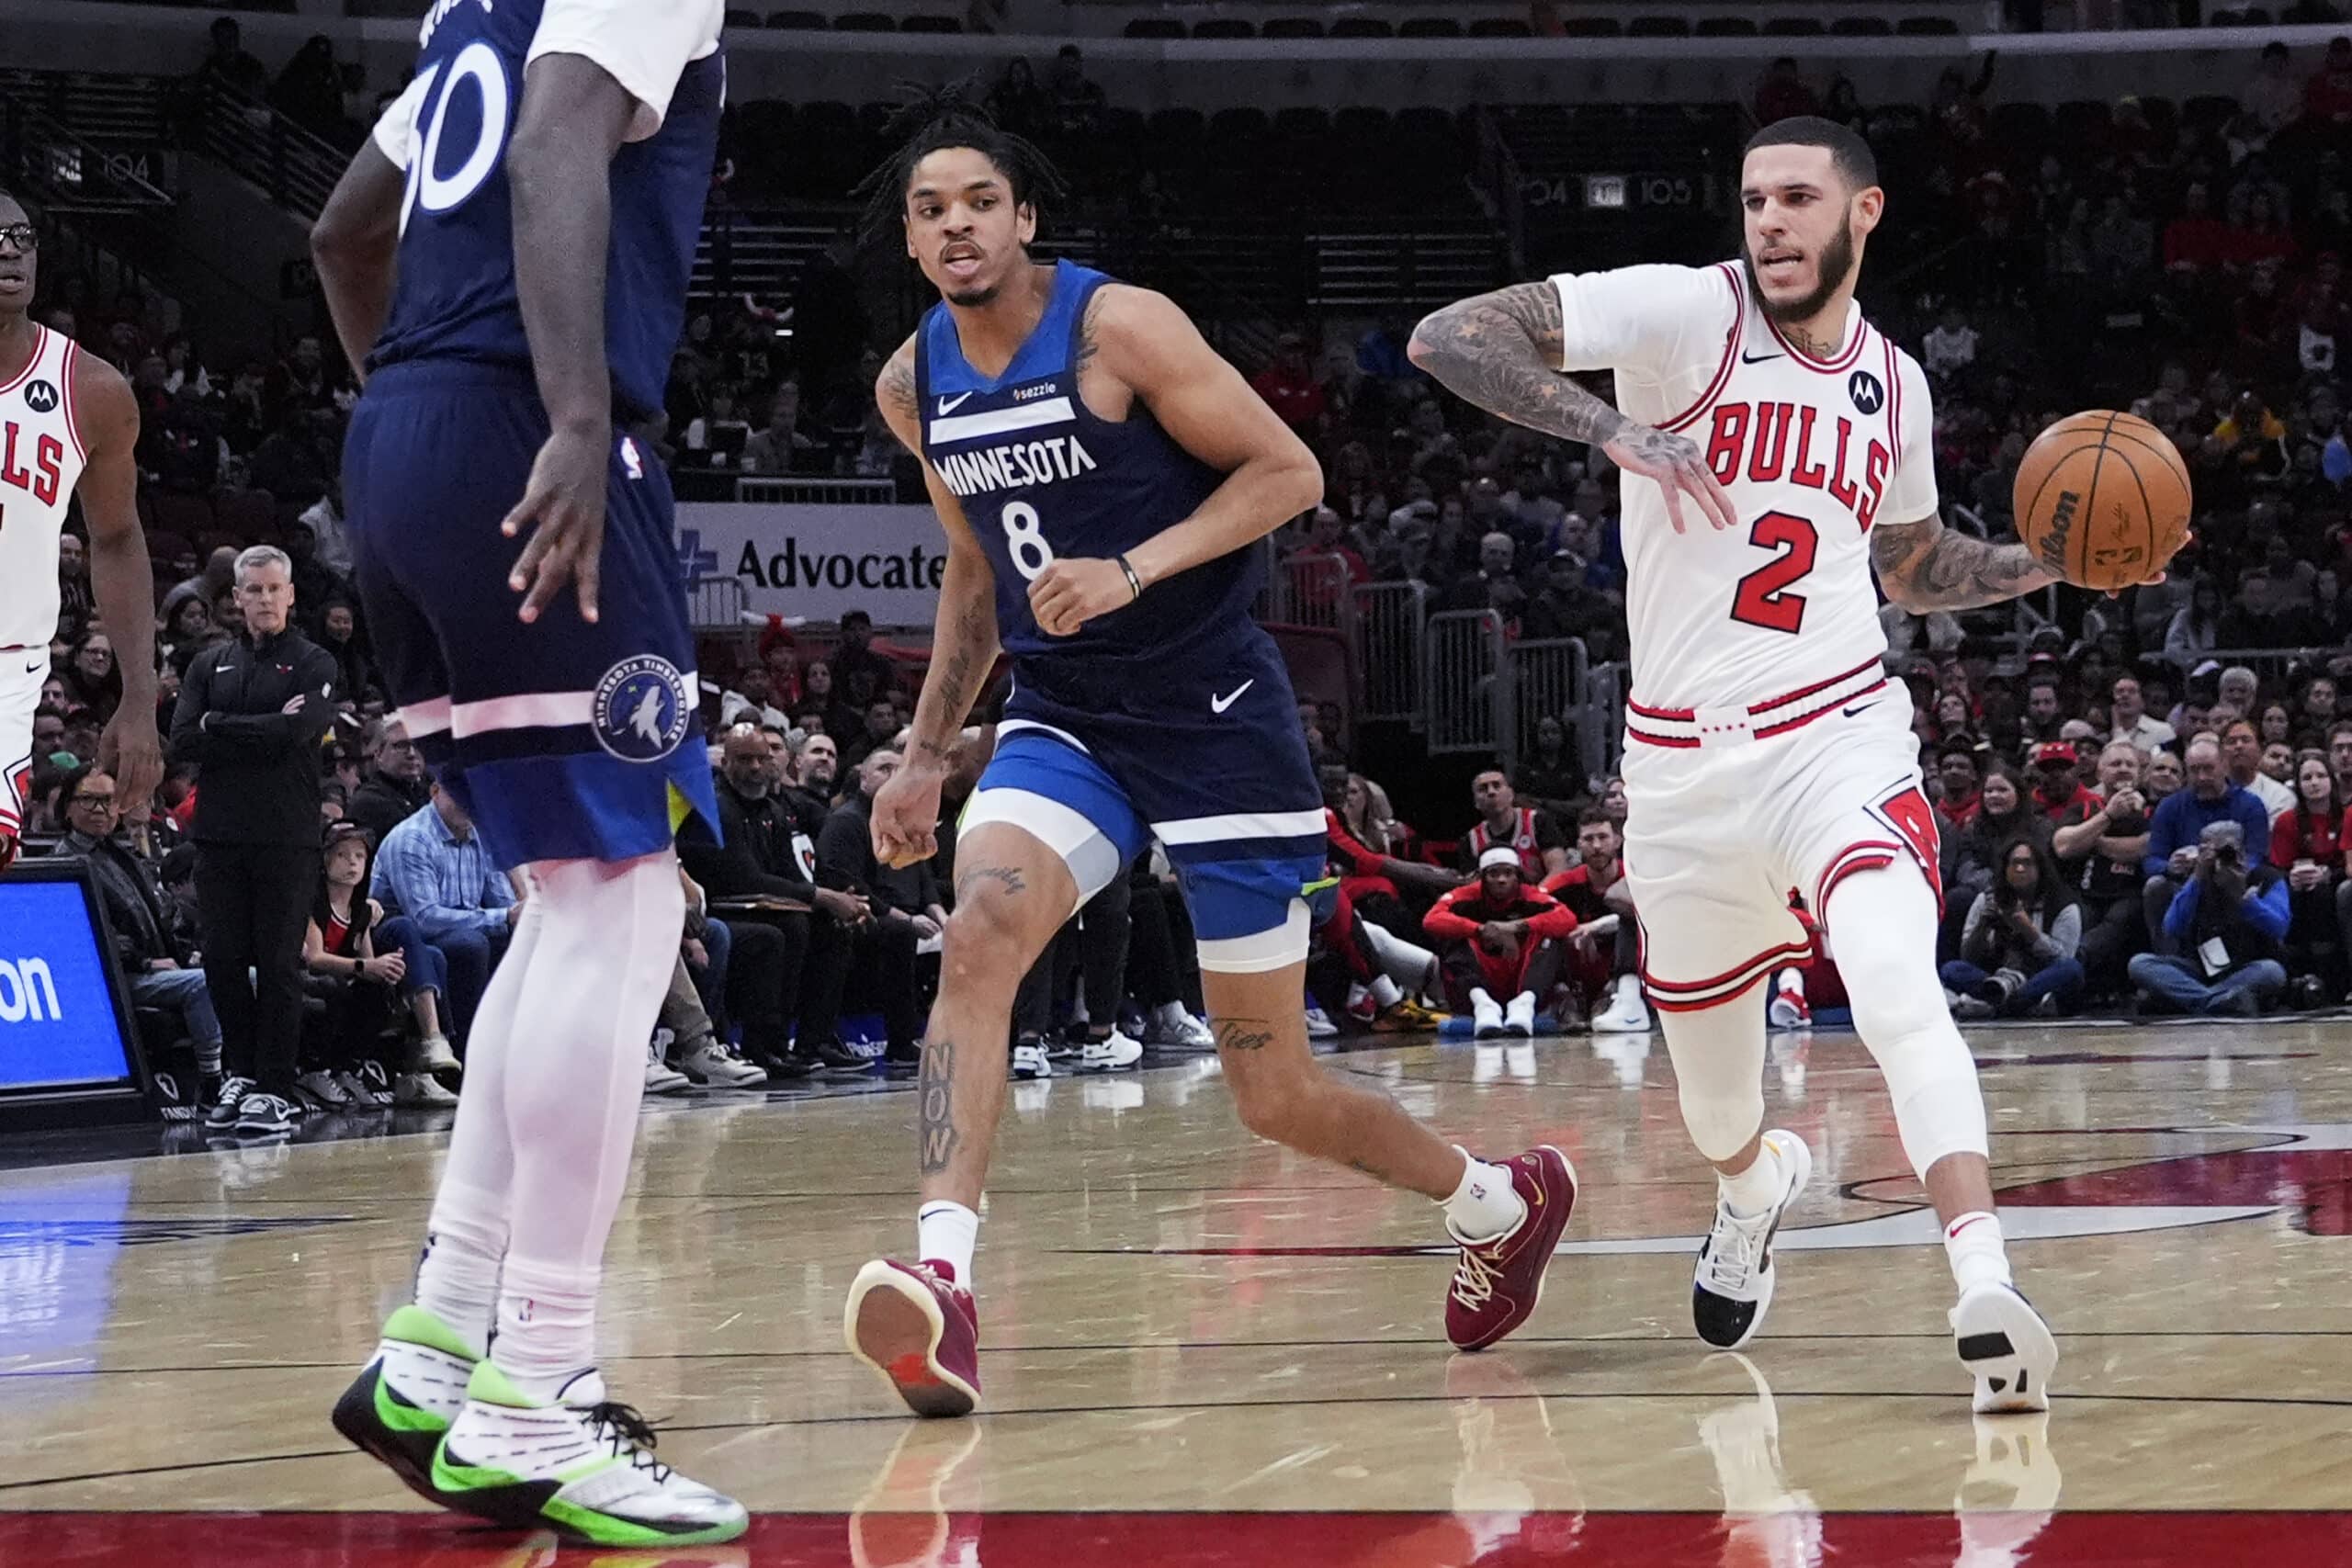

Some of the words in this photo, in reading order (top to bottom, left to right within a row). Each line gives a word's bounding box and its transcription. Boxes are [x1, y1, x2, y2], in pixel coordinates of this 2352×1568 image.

[1641, 178, 1691, 206] 105
[1021, 382, 1056, 399] sezzle
[933, 435, 1097, 496] MINNESOTA
[1705, 401, 1889, 535] BULLS
[737, 536, 948, 590] Advocate
[1001, 501, 1055, 581] 8
[1730, 510, 1819, 635] 2
[924, 1043, 952, 1168] NOW
